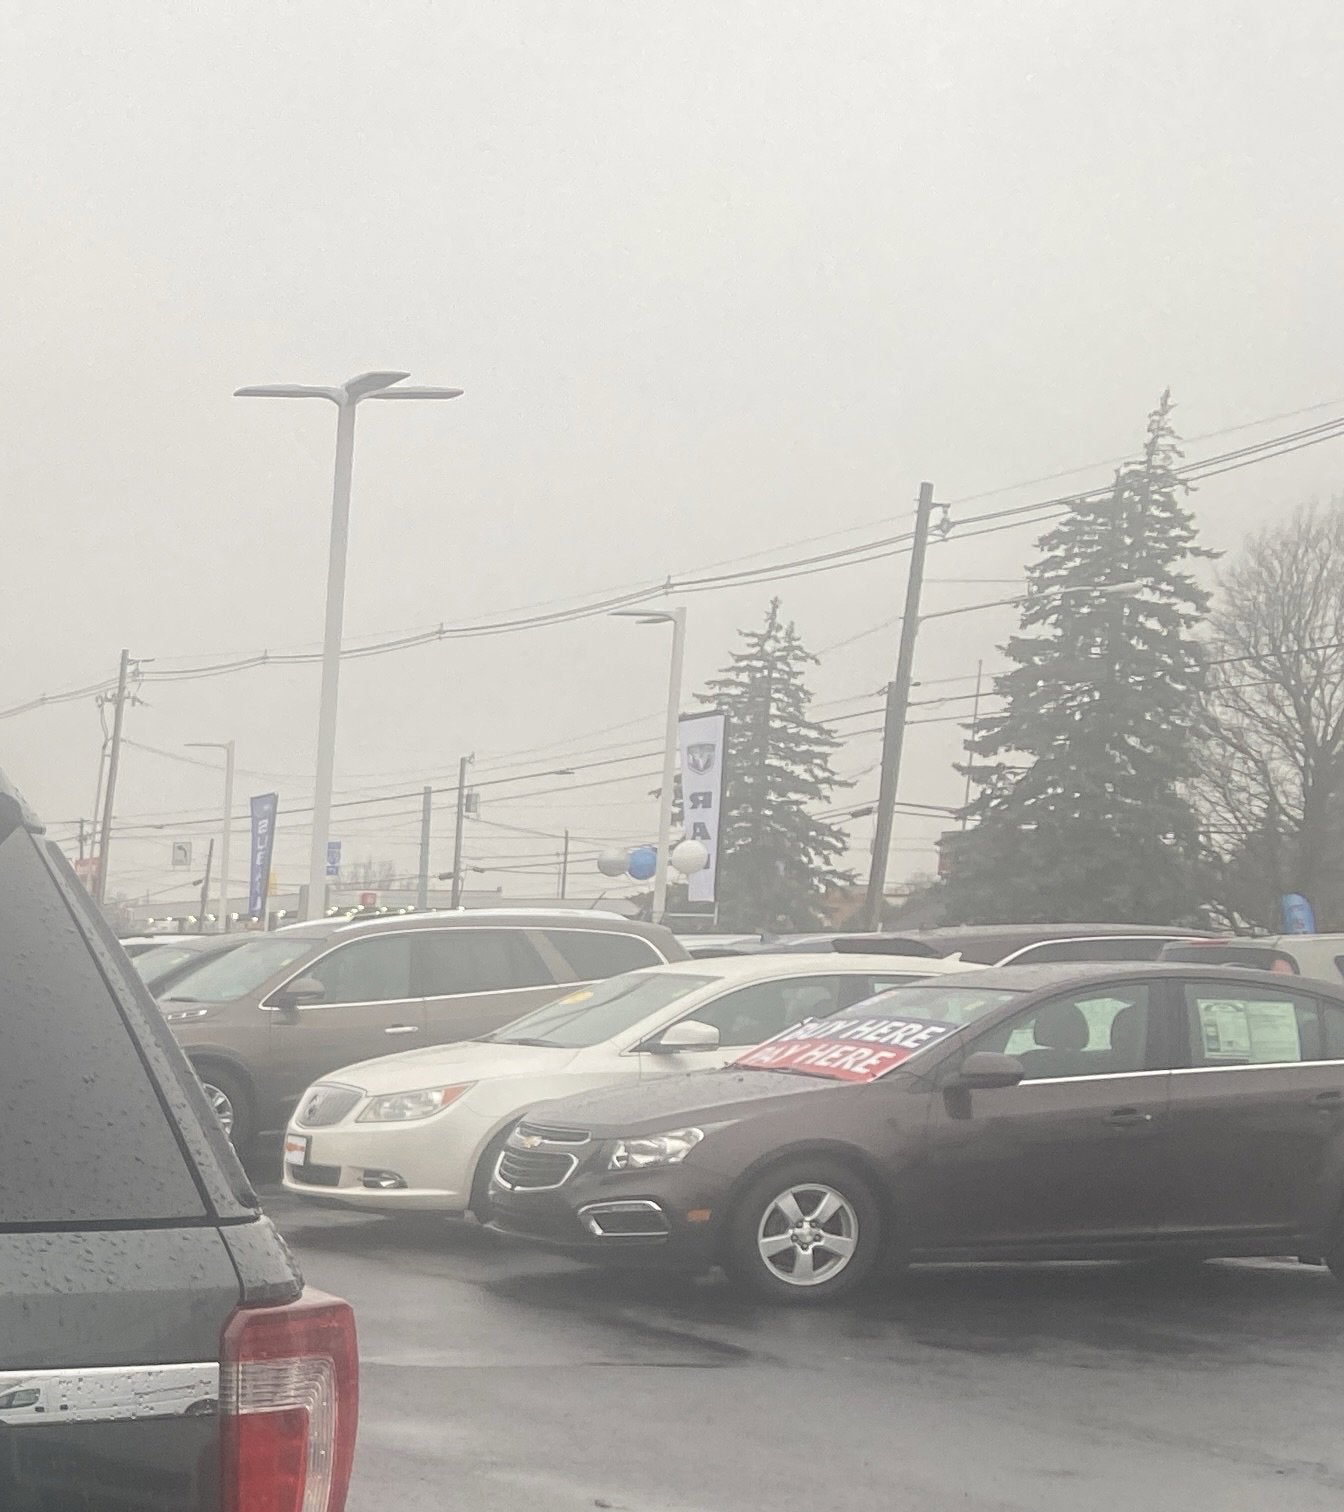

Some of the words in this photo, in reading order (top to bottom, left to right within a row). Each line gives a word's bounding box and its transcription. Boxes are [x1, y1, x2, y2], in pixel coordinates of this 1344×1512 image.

[785, 1020, 859, 1042] BUY
[849, 1020, 946, 1049] HERE
[745, 1044, 812, 1064] PAY
[806, 1044, 897, 1074] HERE
